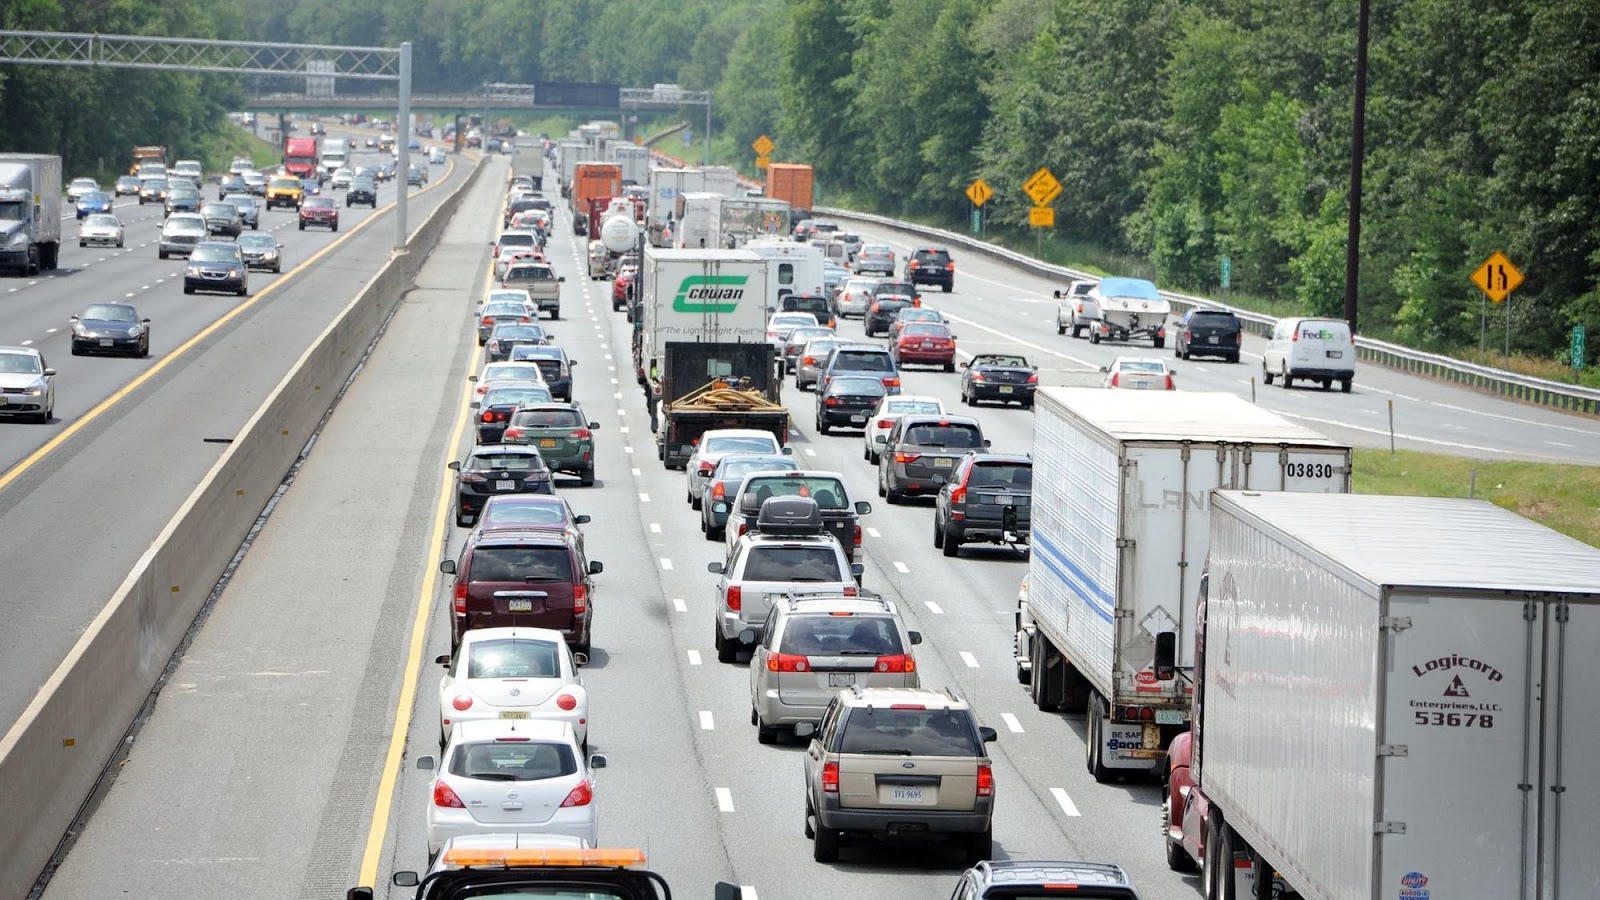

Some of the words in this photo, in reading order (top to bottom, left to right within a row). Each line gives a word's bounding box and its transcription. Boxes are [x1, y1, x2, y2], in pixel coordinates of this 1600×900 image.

[1303, 329, 1334, 340] FedEx
[1287, 462, 1332, 478] 03830
[1412, 654, 1503, 682] Logicorp
[1415, 712, 1493, 728] 53678
[1124, 731, 1142, 739] SAF
